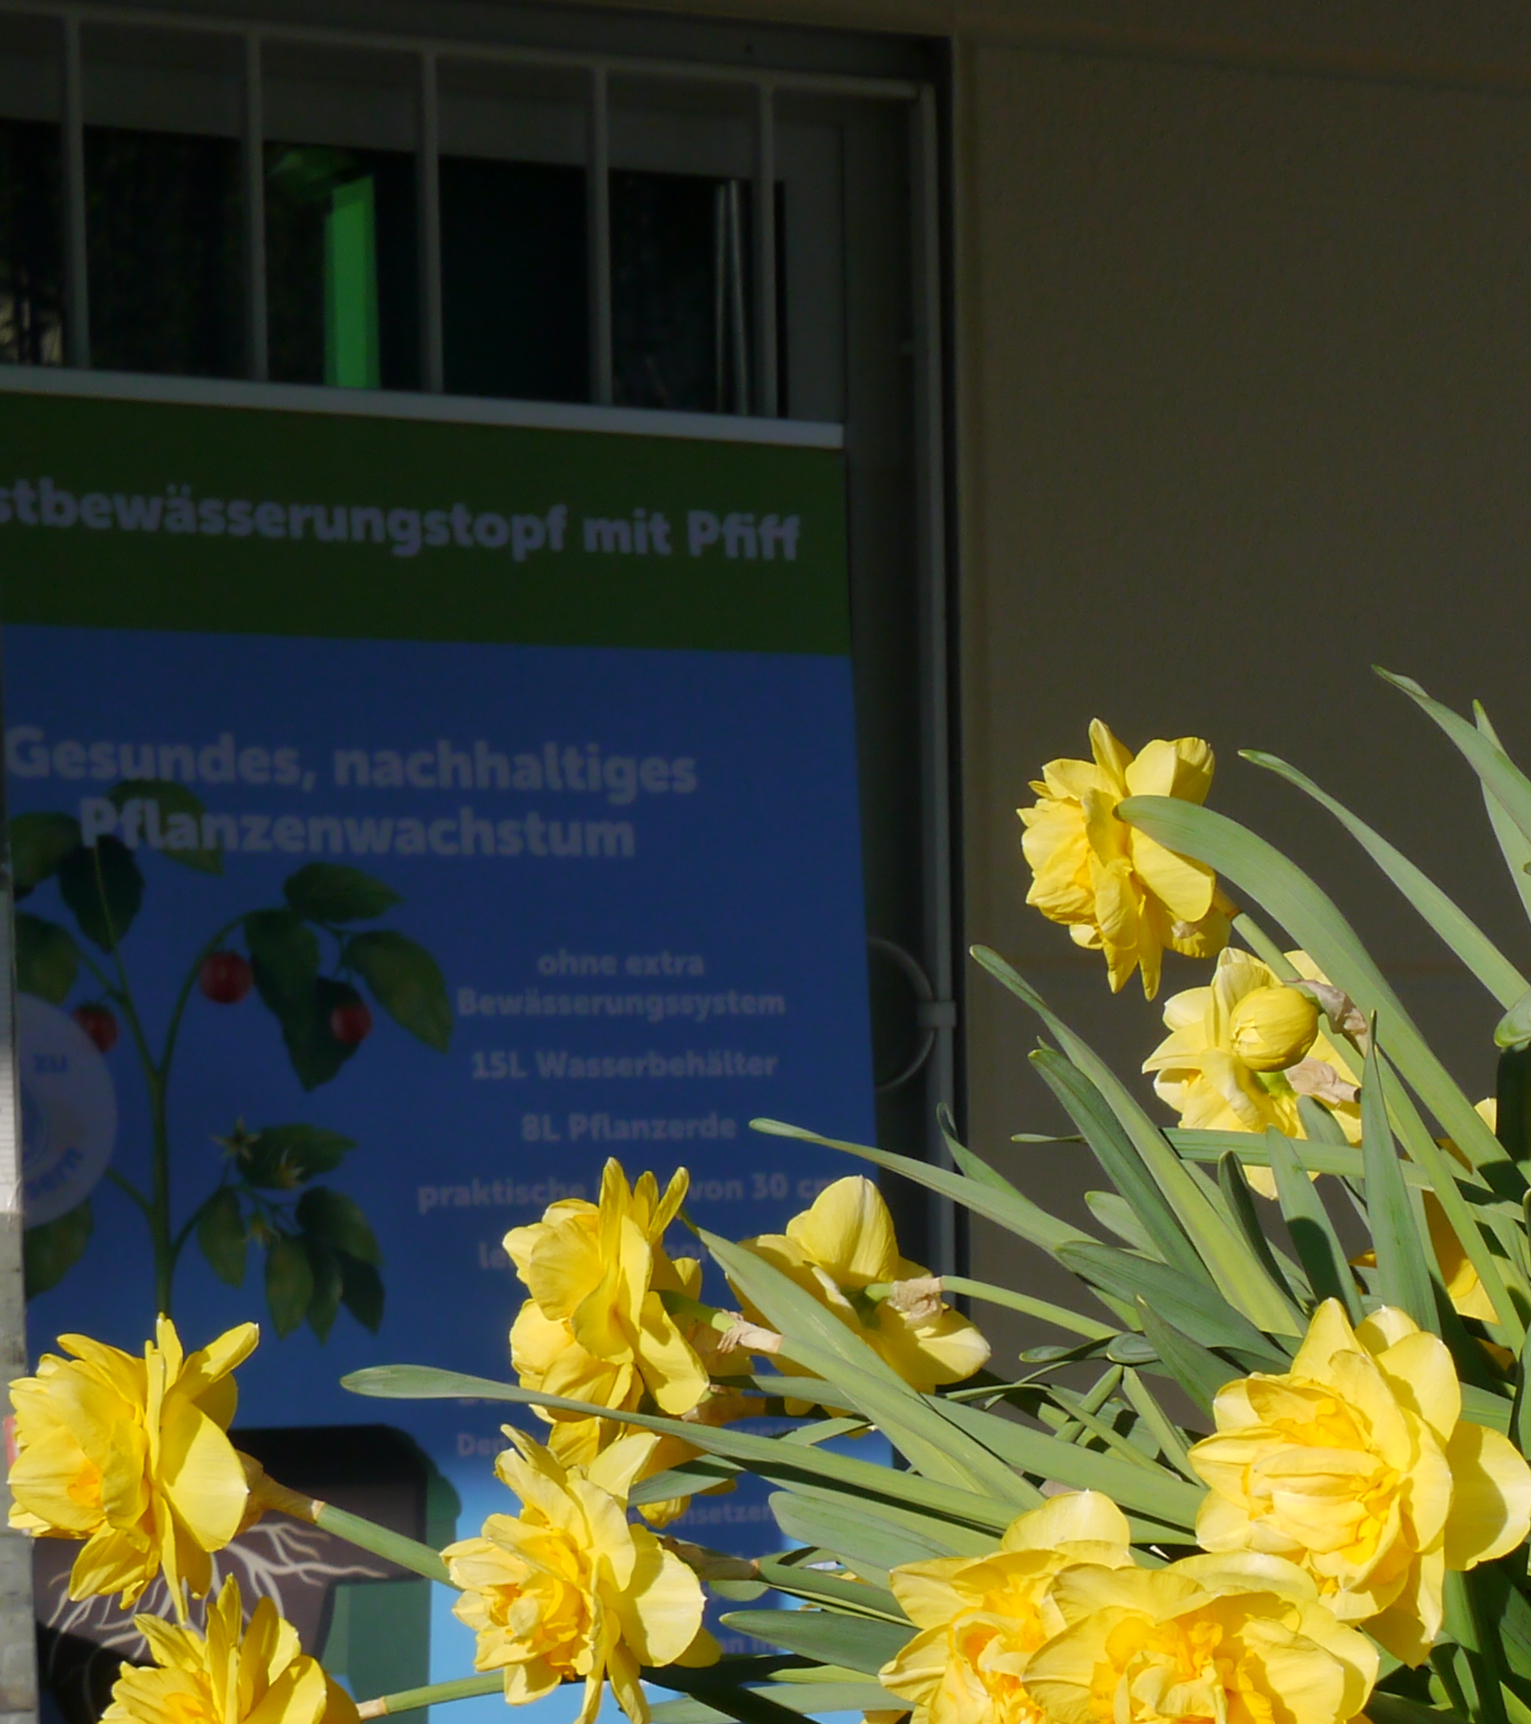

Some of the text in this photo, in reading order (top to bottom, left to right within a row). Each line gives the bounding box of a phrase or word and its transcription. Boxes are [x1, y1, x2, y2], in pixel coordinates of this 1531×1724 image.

[583, 508, 672, 557] mit
[687, 509, 800, 561] Pfiff
[4, 726, 698, 805] Gesundes, nachhaltiges
[79, 797, 636, 858] Pflanzenwachstum
[537, 949, 704, 976] ohne extra
[458, 988, 785, 1022] Bewässerungssystem
[472, 1051, 778, 1080] 15L Wasserbehälter
[522, 1113, 737, 1141] 8L Pflanzerde
[417, 1177, 586, 1214] praktische
[689, 1179, 743, 1202] von
[752, 1174, 788, 1200] 30
